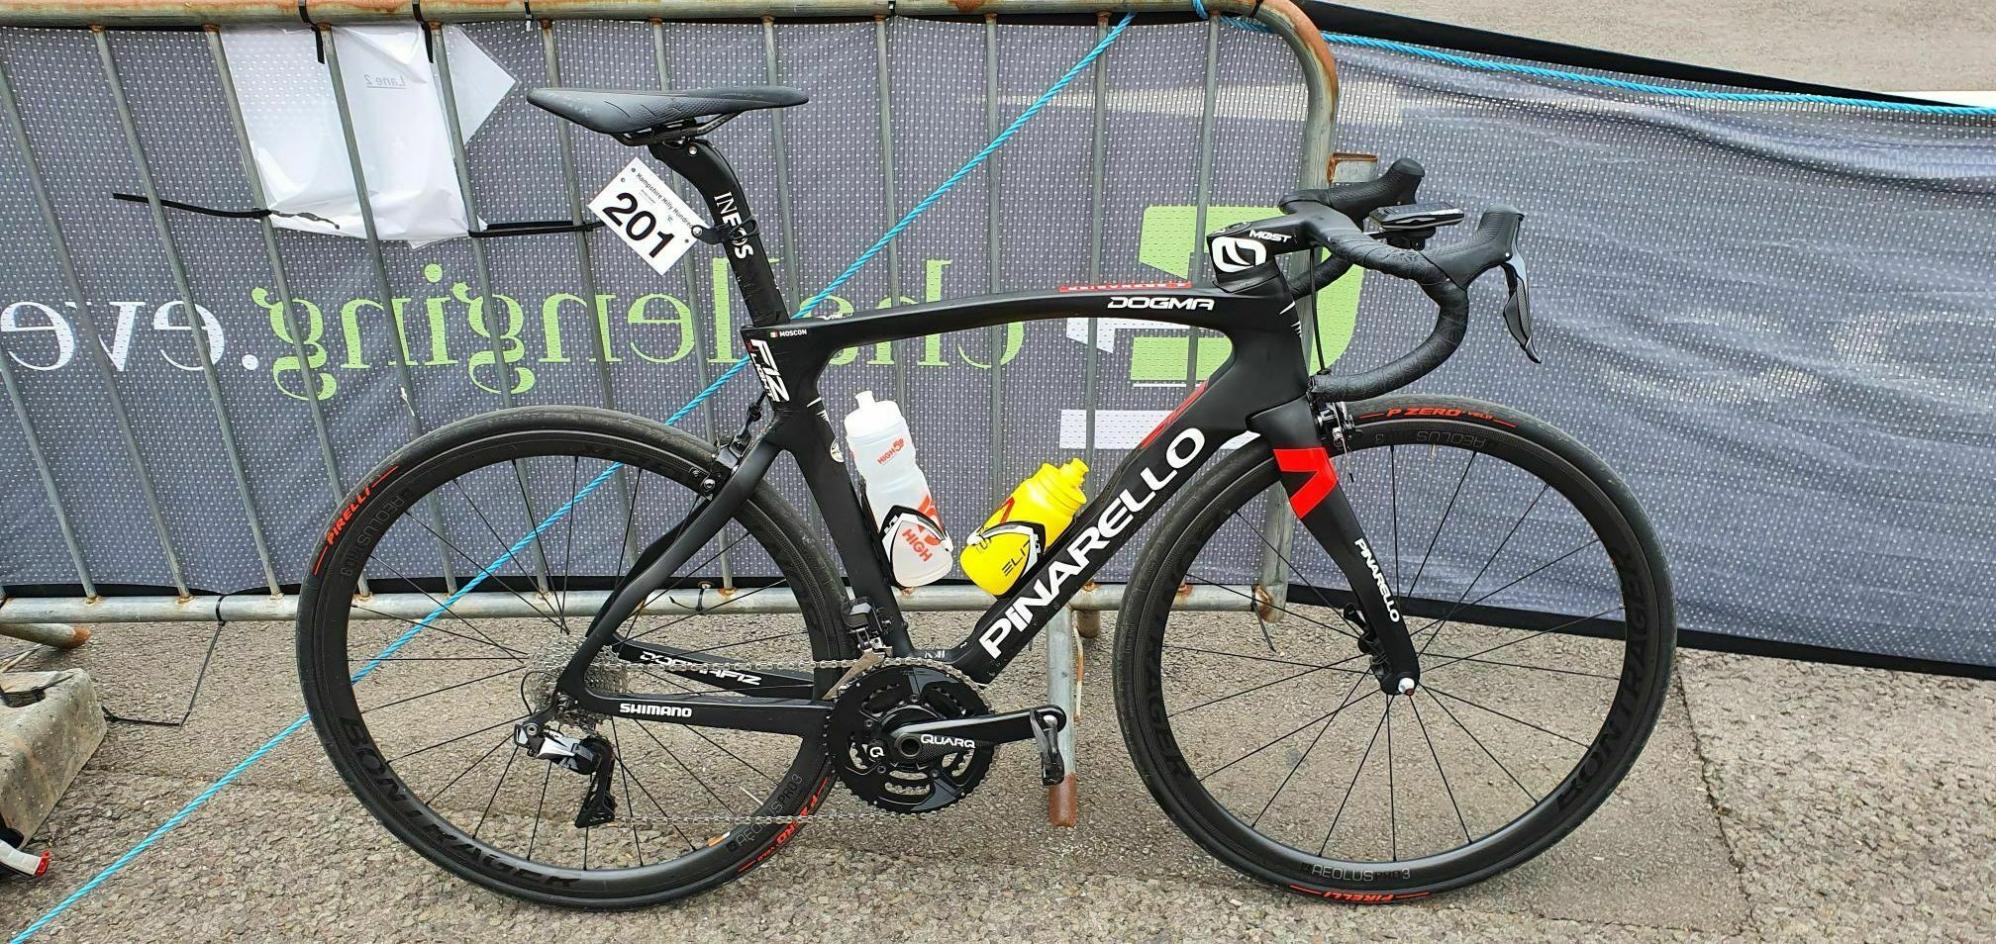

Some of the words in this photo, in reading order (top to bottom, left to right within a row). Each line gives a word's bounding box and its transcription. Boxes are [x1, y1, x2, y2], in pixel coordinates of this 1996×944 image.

[602, 192, 675, 258] 201
[714, 191, 754, 259] INEOS
[1107, 296, 1215, 311] DOGMA
[779, 329, 808, 338] MOSCON
[1386, 407, 1402, 417] P
[1404, 407, 1461, 417] ZERO
[1416, 430, 1487, 448] AEOLUS
[325, 485, 371, 545] PIRELLI
[902, 528, 933, 562] HIGH
[979, 427, 1205, 660] PINARELLO
[1354, 537, 1400, 622] PINARELLO
[619, 703, 692, 718] SHIMANO
[920, 733, 976, 750] QUARQ
[1311, 864, 1374, 882] AEOLUS
[1401, 867, 1411, 880] 3
[1323, 890, 1395, 903] PIRELLI
